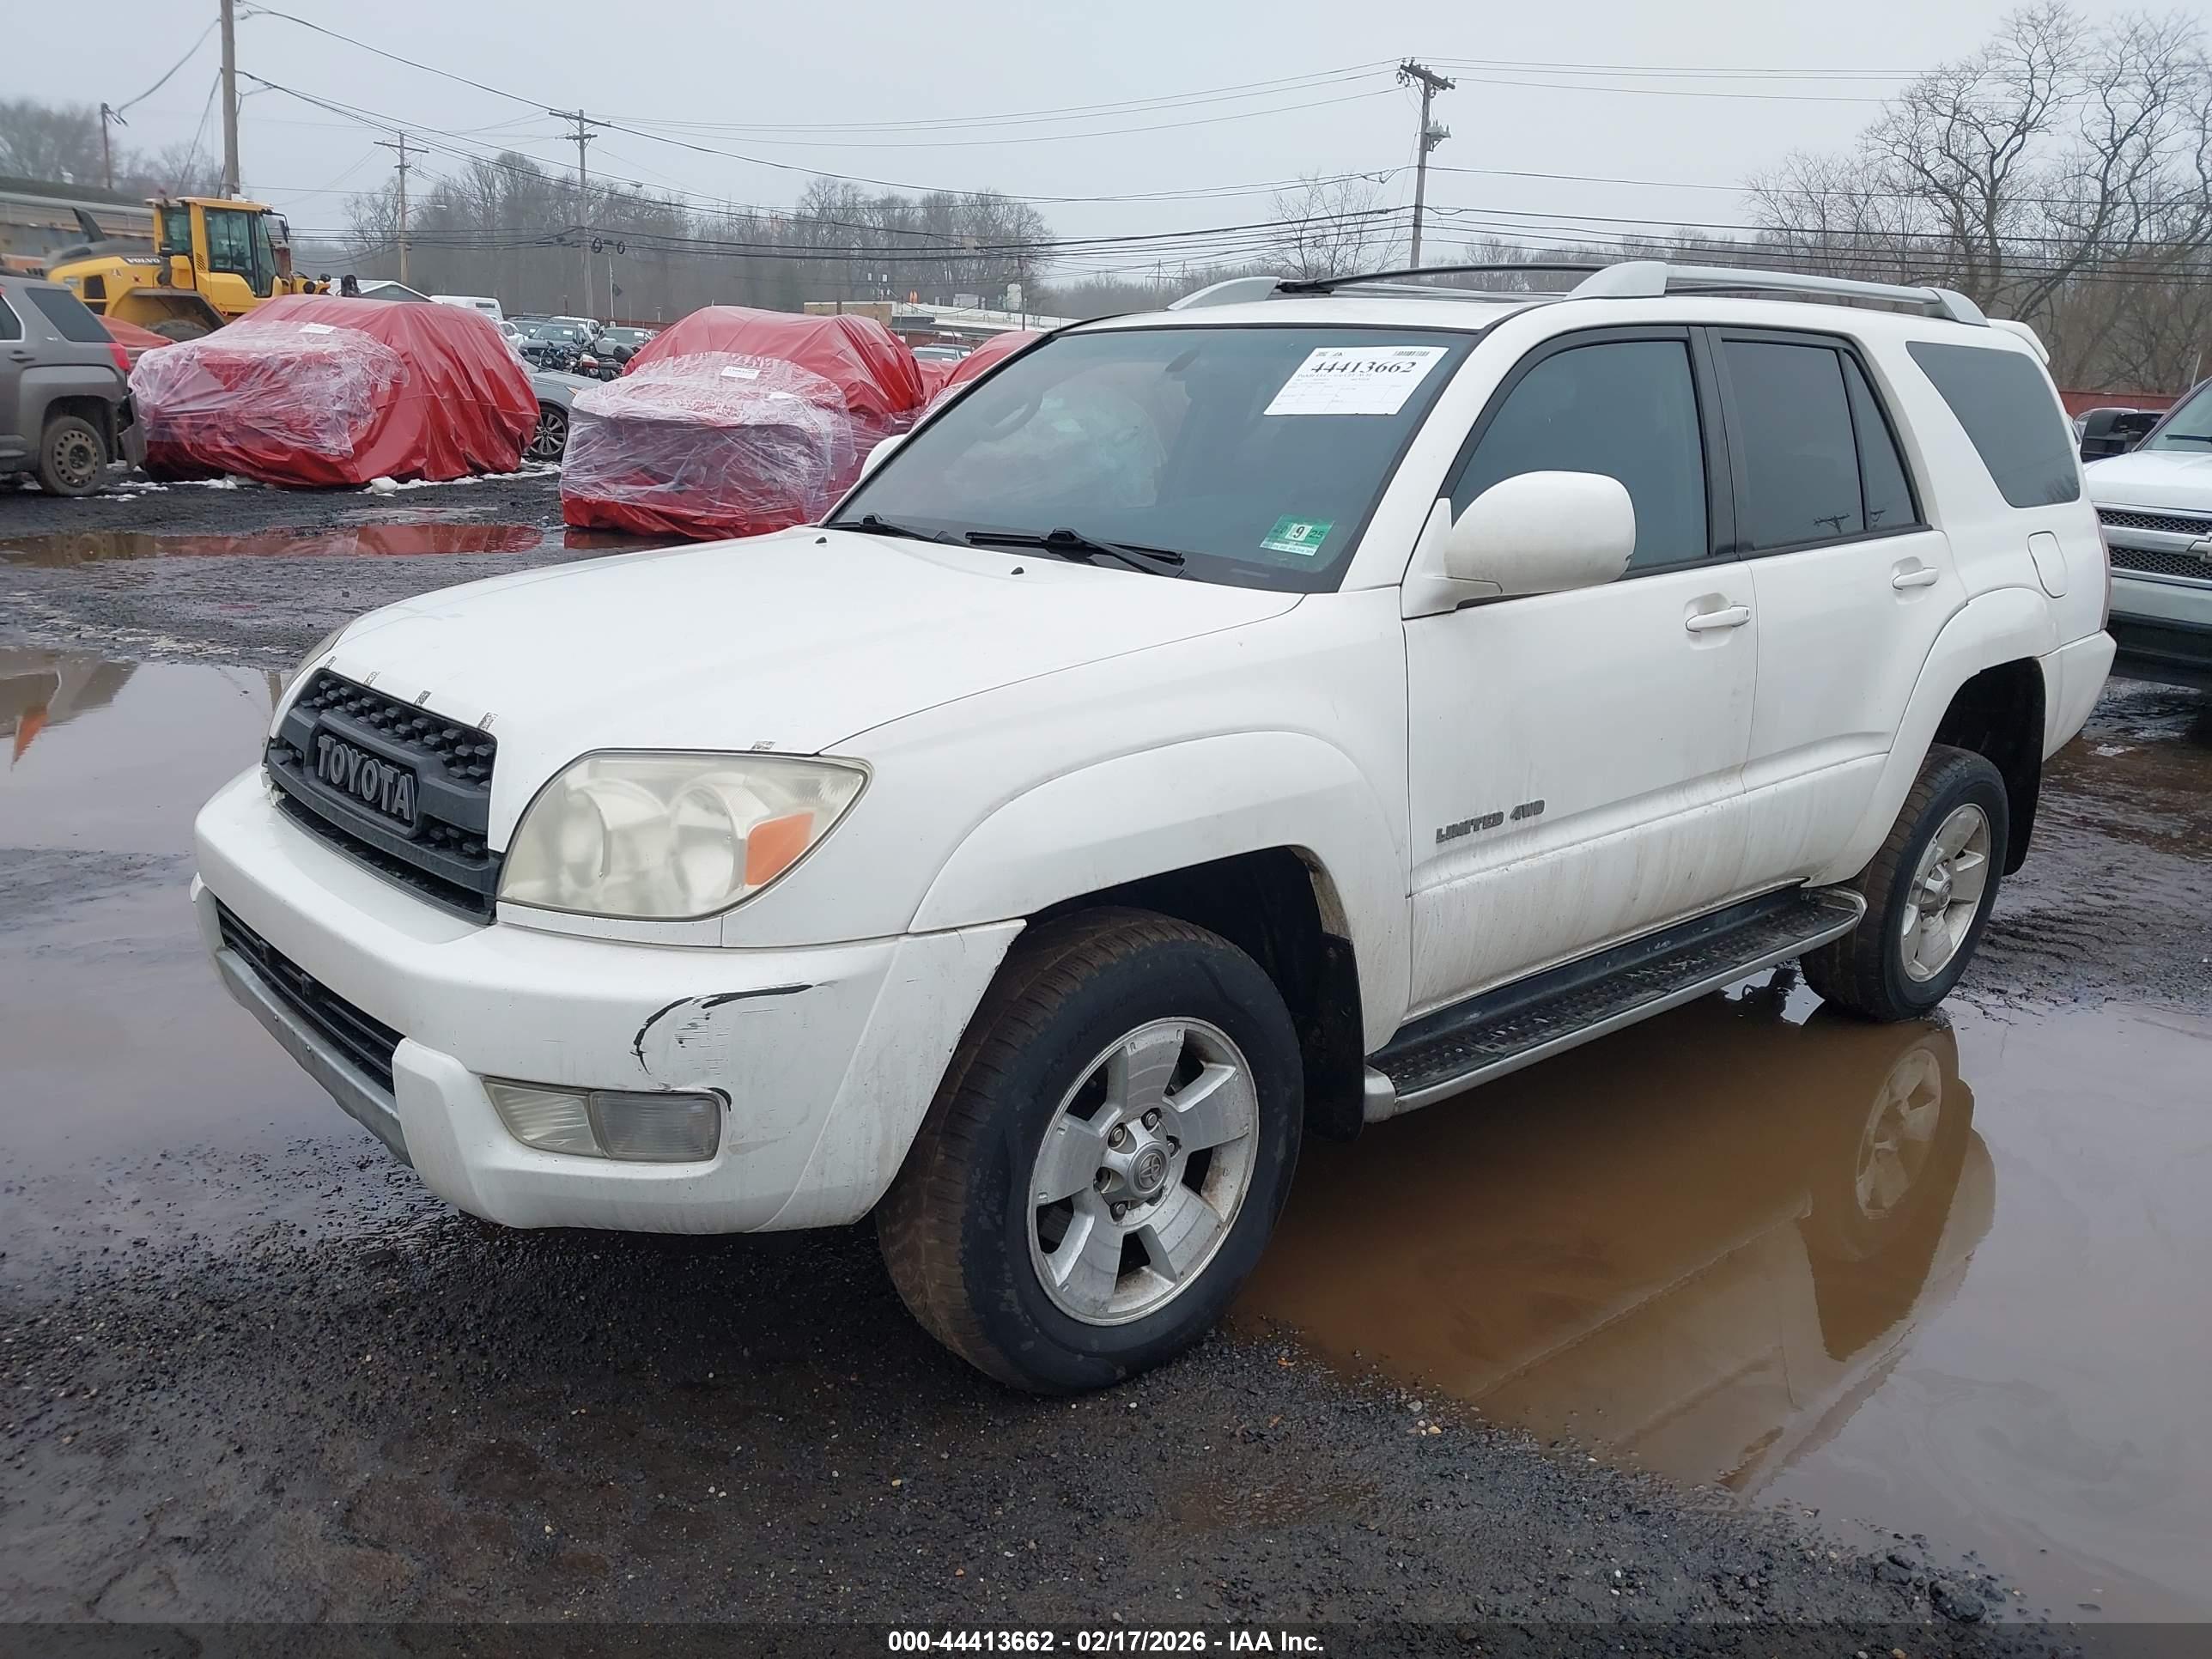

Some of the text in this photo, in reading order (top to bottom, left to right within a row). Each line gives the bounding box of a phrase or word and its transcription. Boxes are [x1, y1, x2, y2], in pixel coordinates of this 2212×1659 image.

[1311, 361, 1417, 374] 44413662
[1293, 526, 1306, 538] 9
[1309, 530, 1326, 539] 25
[318, 735, 416, 821] TOYOTA
[1436, 799, 1545, 843] LIMITED 4WD
